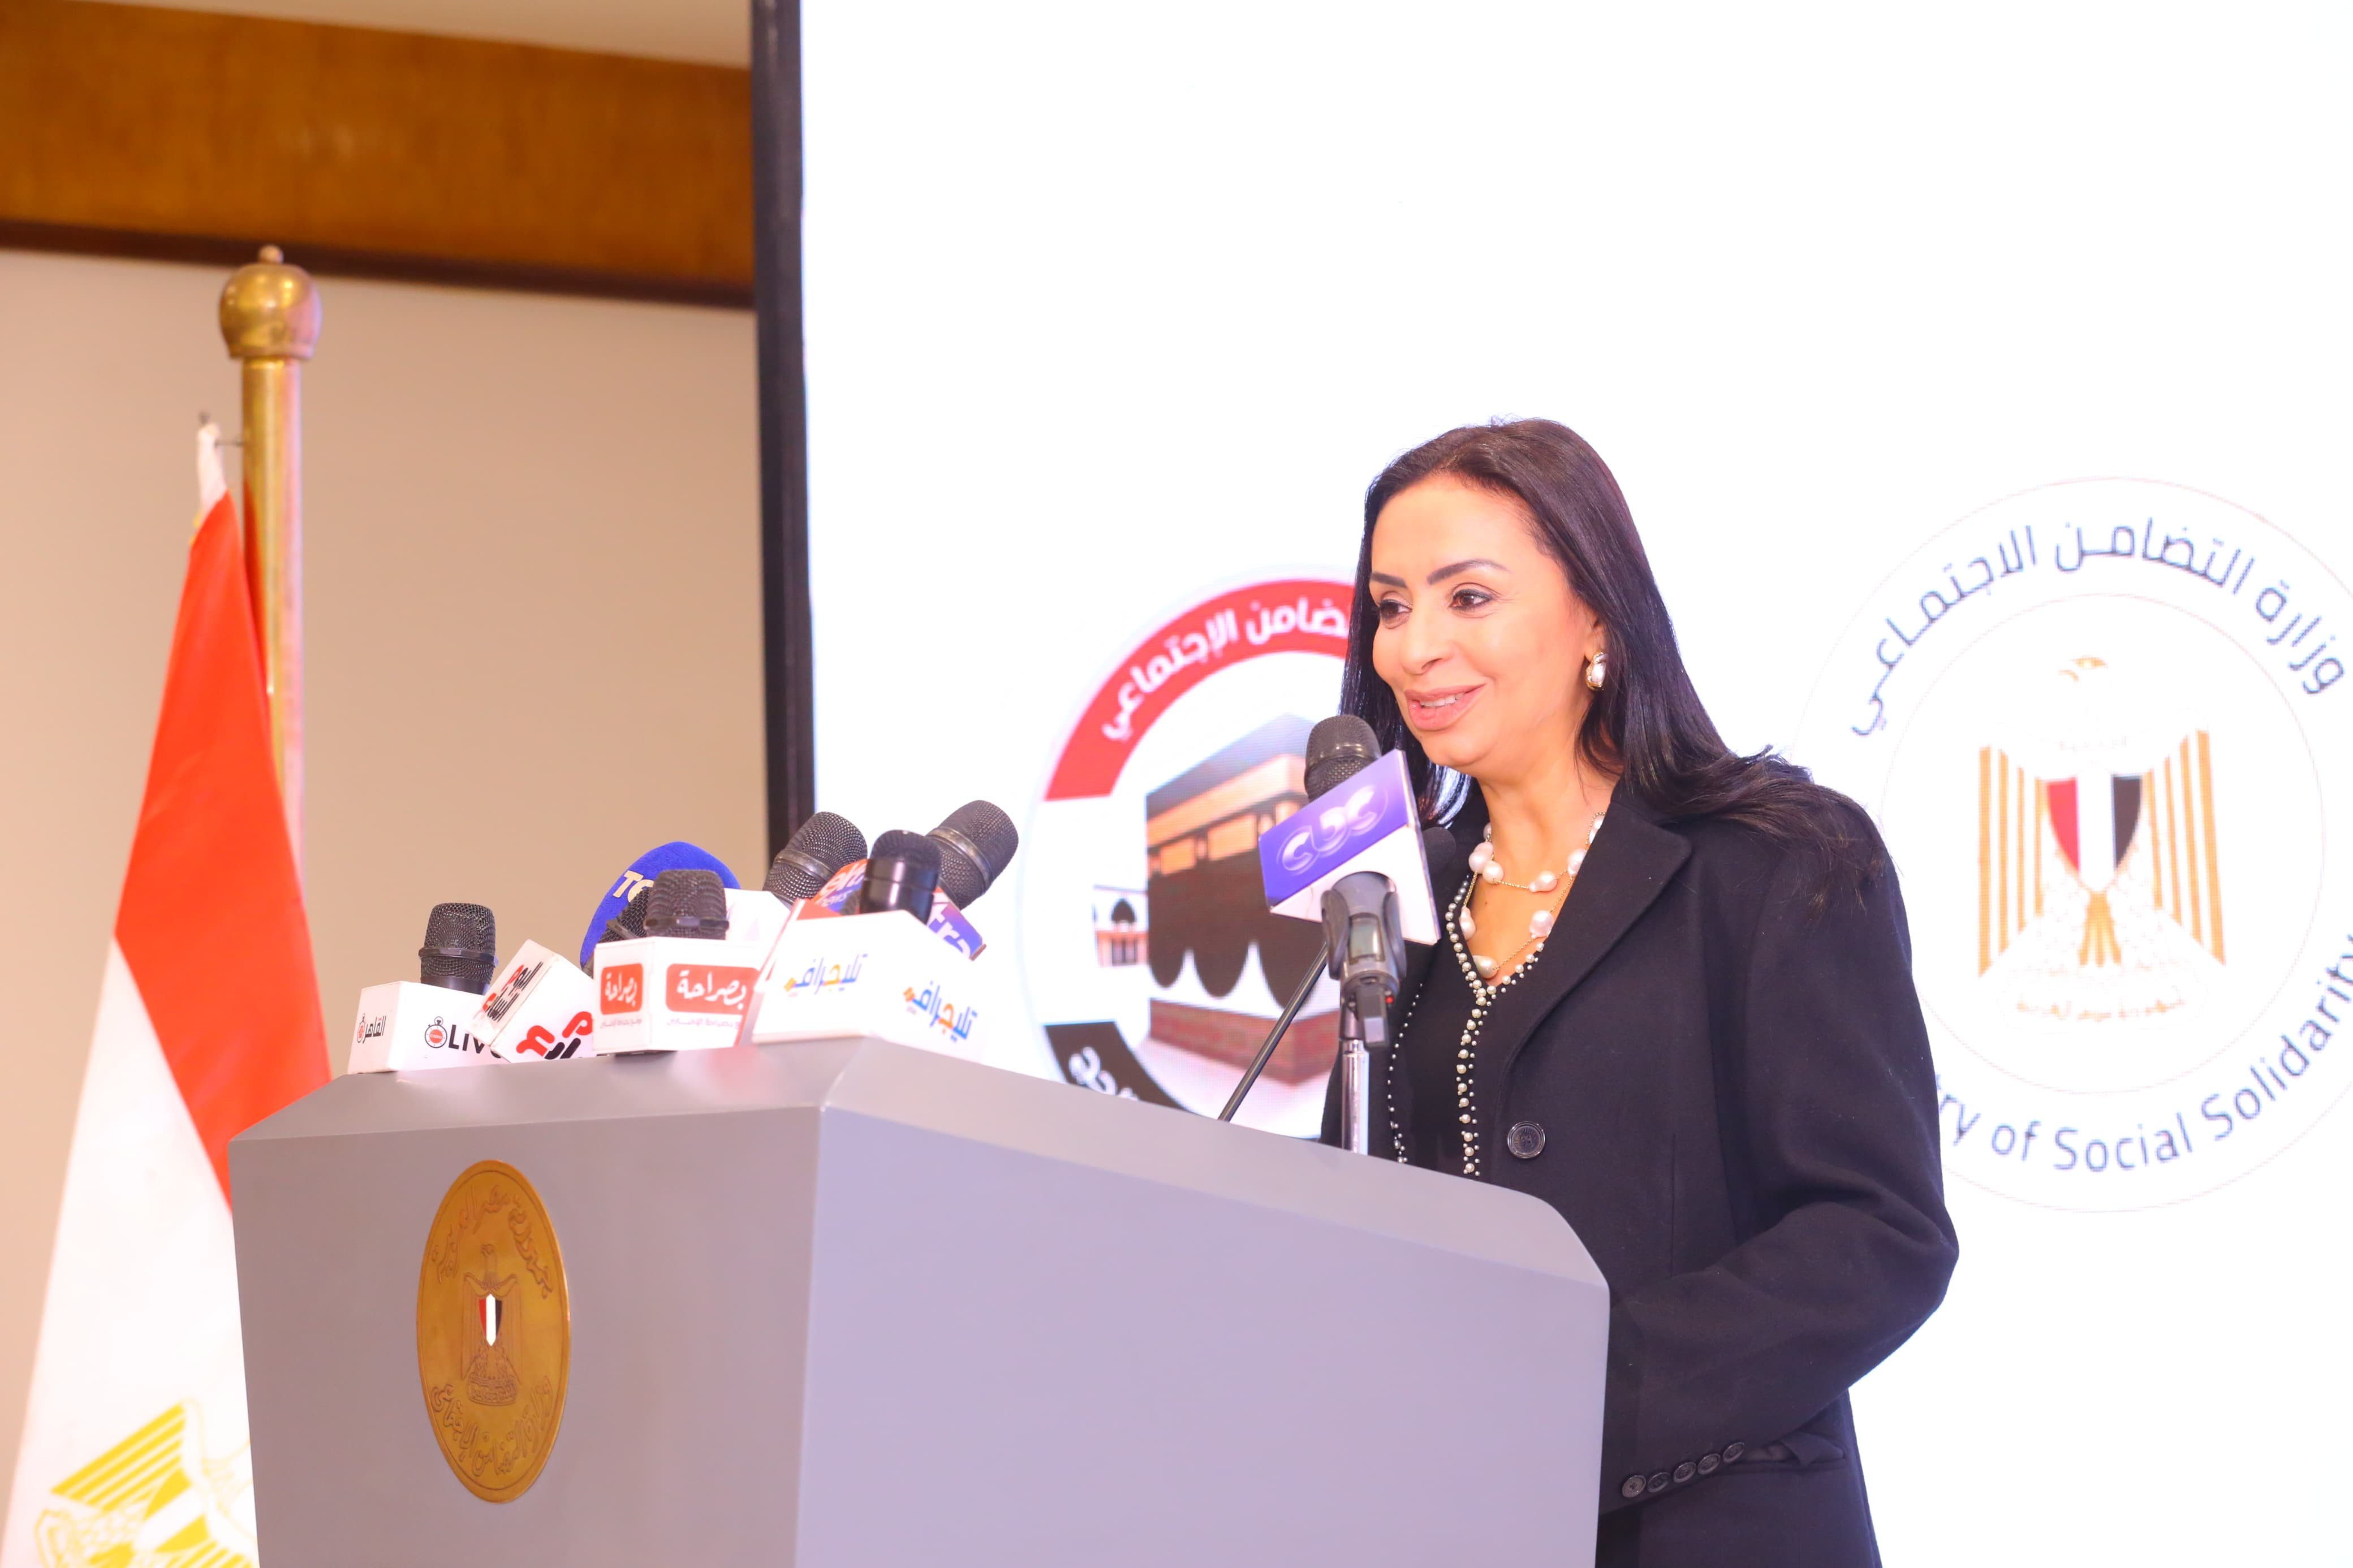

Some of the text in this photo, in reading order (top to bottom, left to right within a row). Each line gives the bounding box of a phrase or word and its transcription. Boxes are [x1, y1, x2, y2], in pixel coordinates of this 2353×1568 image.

[2054, 517, 2256, 596] التضامن
[1246, 596, 1348, 645] ضامن
[2256, 579, 2346, 696] وزارة
[605, 972, 637, 1007] بصراحة
[676, 969, 747, 1010] بصراحة
[1991, 1120, 2041, 1161] of
[2053, 1112, 2193, 1173] Social
